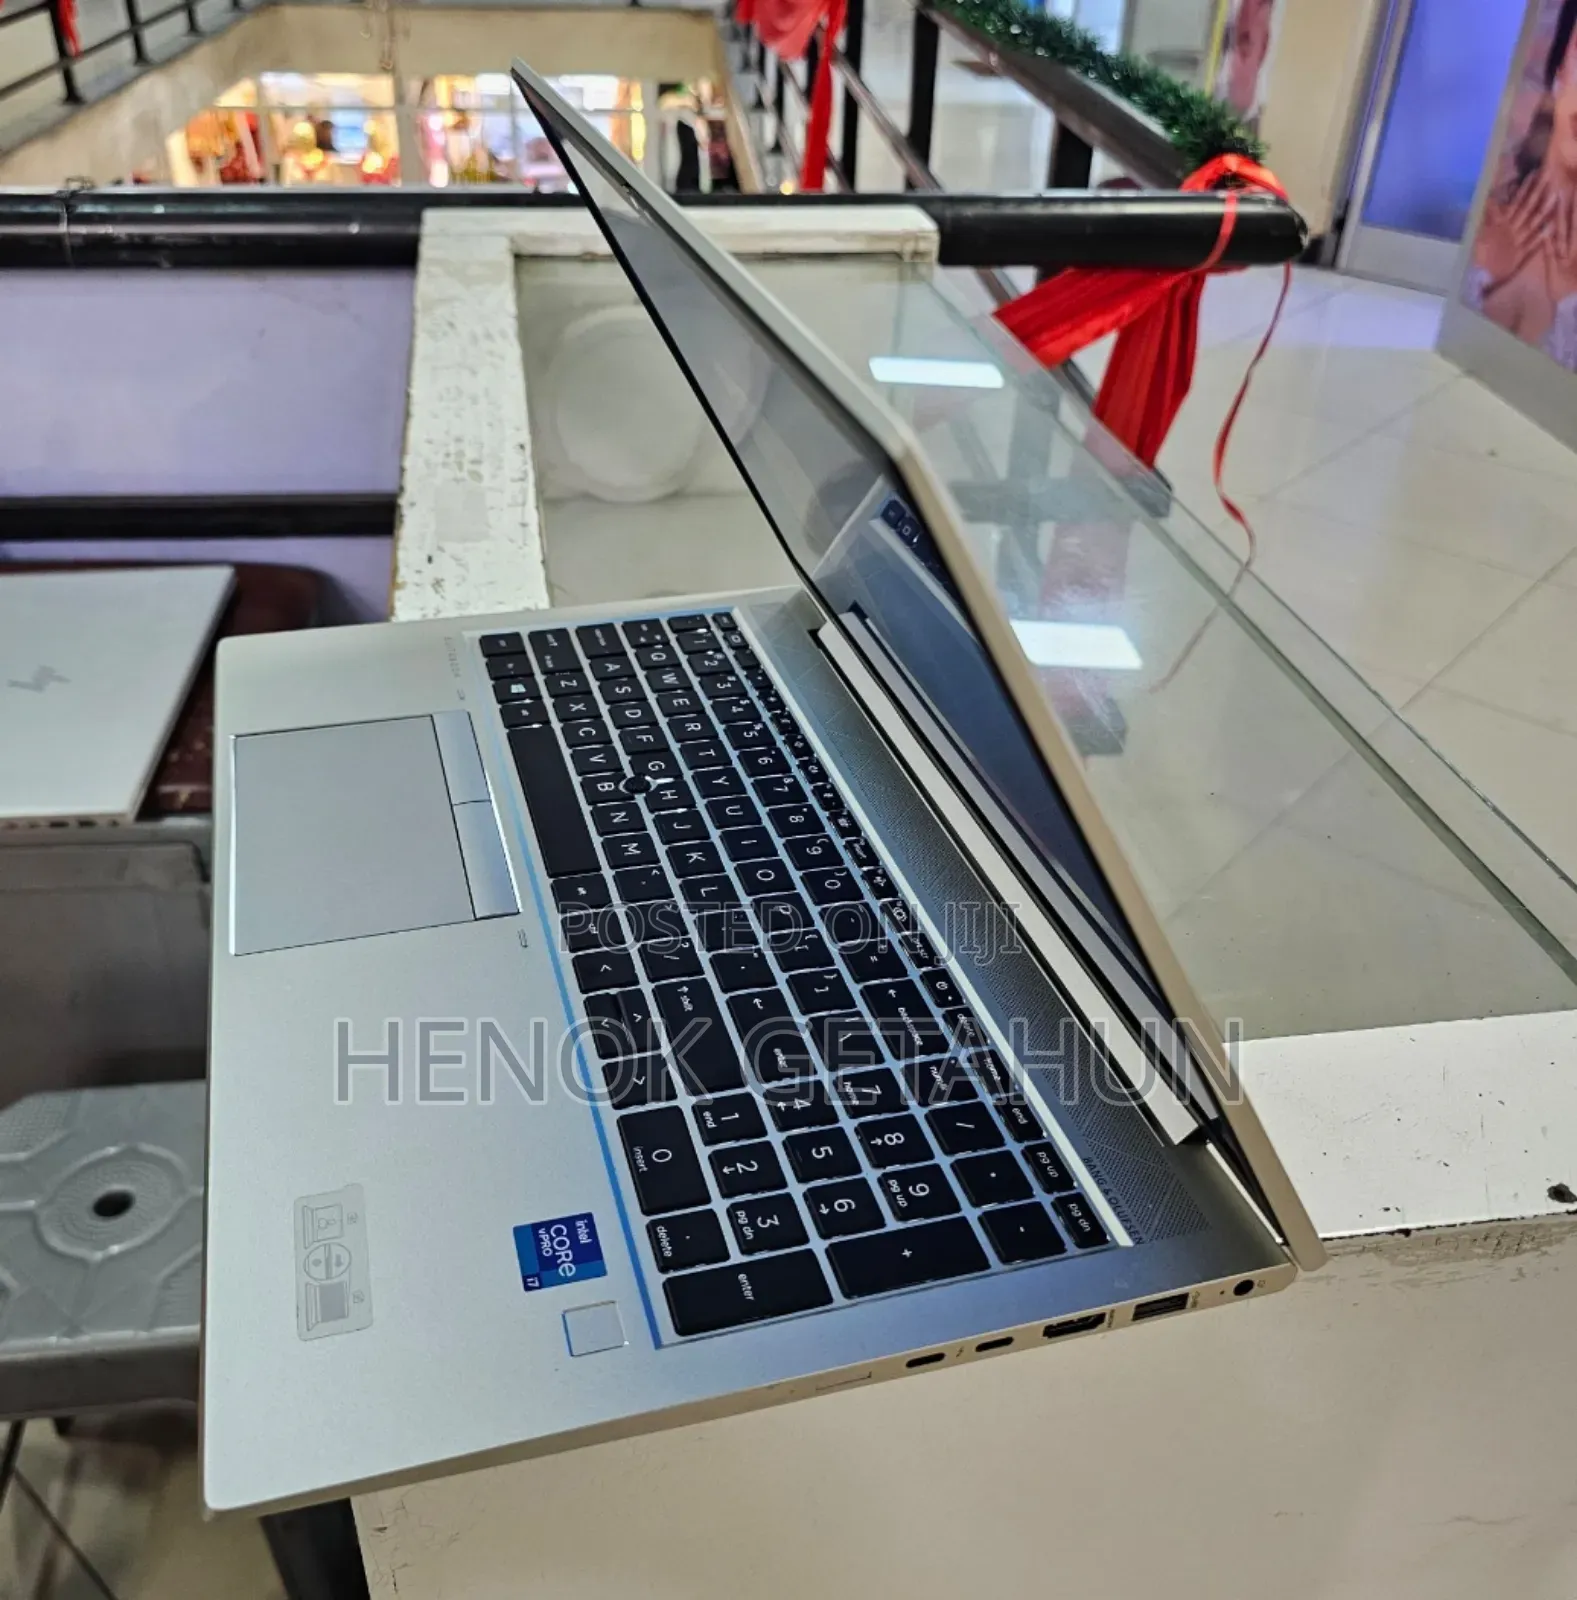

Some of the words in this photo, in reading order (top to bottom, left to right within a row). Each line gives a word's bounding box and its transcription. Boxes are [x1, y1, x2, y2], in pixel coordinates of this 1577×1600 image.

[604, 662, 620, 673] A
[704, 660, 719, 668] 2
[560, 680, 578, 688] Z
[661, 673, 680, 685] W
[615, 686, 632, 695] S
[569, 703, 587, 712] X
[672, 698, 691, 707] E
[625, 709, 642, 718] D
[578, 727, 596, 737] C
[685, 723, 701, 731] R
[636, 734, 654, 743] F
[743, 730, 759, 738] 5
[588, 753, 606, 764] V
[698, 749, 716, 757] T
[647, 760, 665, 771] G
[757, 757, 773, 765] 6
[711, 775, 729, 785] Y
[596, 782, 615, 792] B
[659, 789, 678, 800] H
[725, 805, 743, 816] U
[610, 811, 629, 823] N
[789, 815, 805, 823] 8
[673, 821, 691, 830] J
[621, 842, 641, 856] M
[806, 846, 822, 855] 9
[685, 852, 706, 863] K
[756, 869, 775, 881] O
[700, 886, 719, 897] L
[861, 1084, 883, 1096] 7
[793, 1098, 812, 1110] 4
[702, 1110, 717, 1129] end
[721, 1112, 740, 1121] 1
[1011, 1107, 1029, 1125] end
[883, 1132, 905, 1146] 8
[811, 1146, 834, 1160] 5
[632, 1146, 648, 1173] insert
[1036, 1151, 1050, 1165] pg
[1046, 1165, 1060, 1179] up
[736, 1160, 759, 1174] 2
[887, 1179, 901, 1193] pg
[896, 1194, 909, 1208] up
[908, 1183, 930, 1197] 9
[833, 1199, 856, 1213] 6
[756, 1214, 780, 1228] 3
[1067, 1203, 1082, 1217] pg
[1077, 1218, 1091, 1232] dn
[735, 1210, 748, 1225] pg
[742, 1225, 755, 1240] dn
[575, 1219, 592, 1244] intel
[538, 1228, 553, 1257] vPRO
[656, 1225, 672, 1257] delete
[526, 1277, 540, 1287] i7
[738, 1273, 755, 1301] enter
